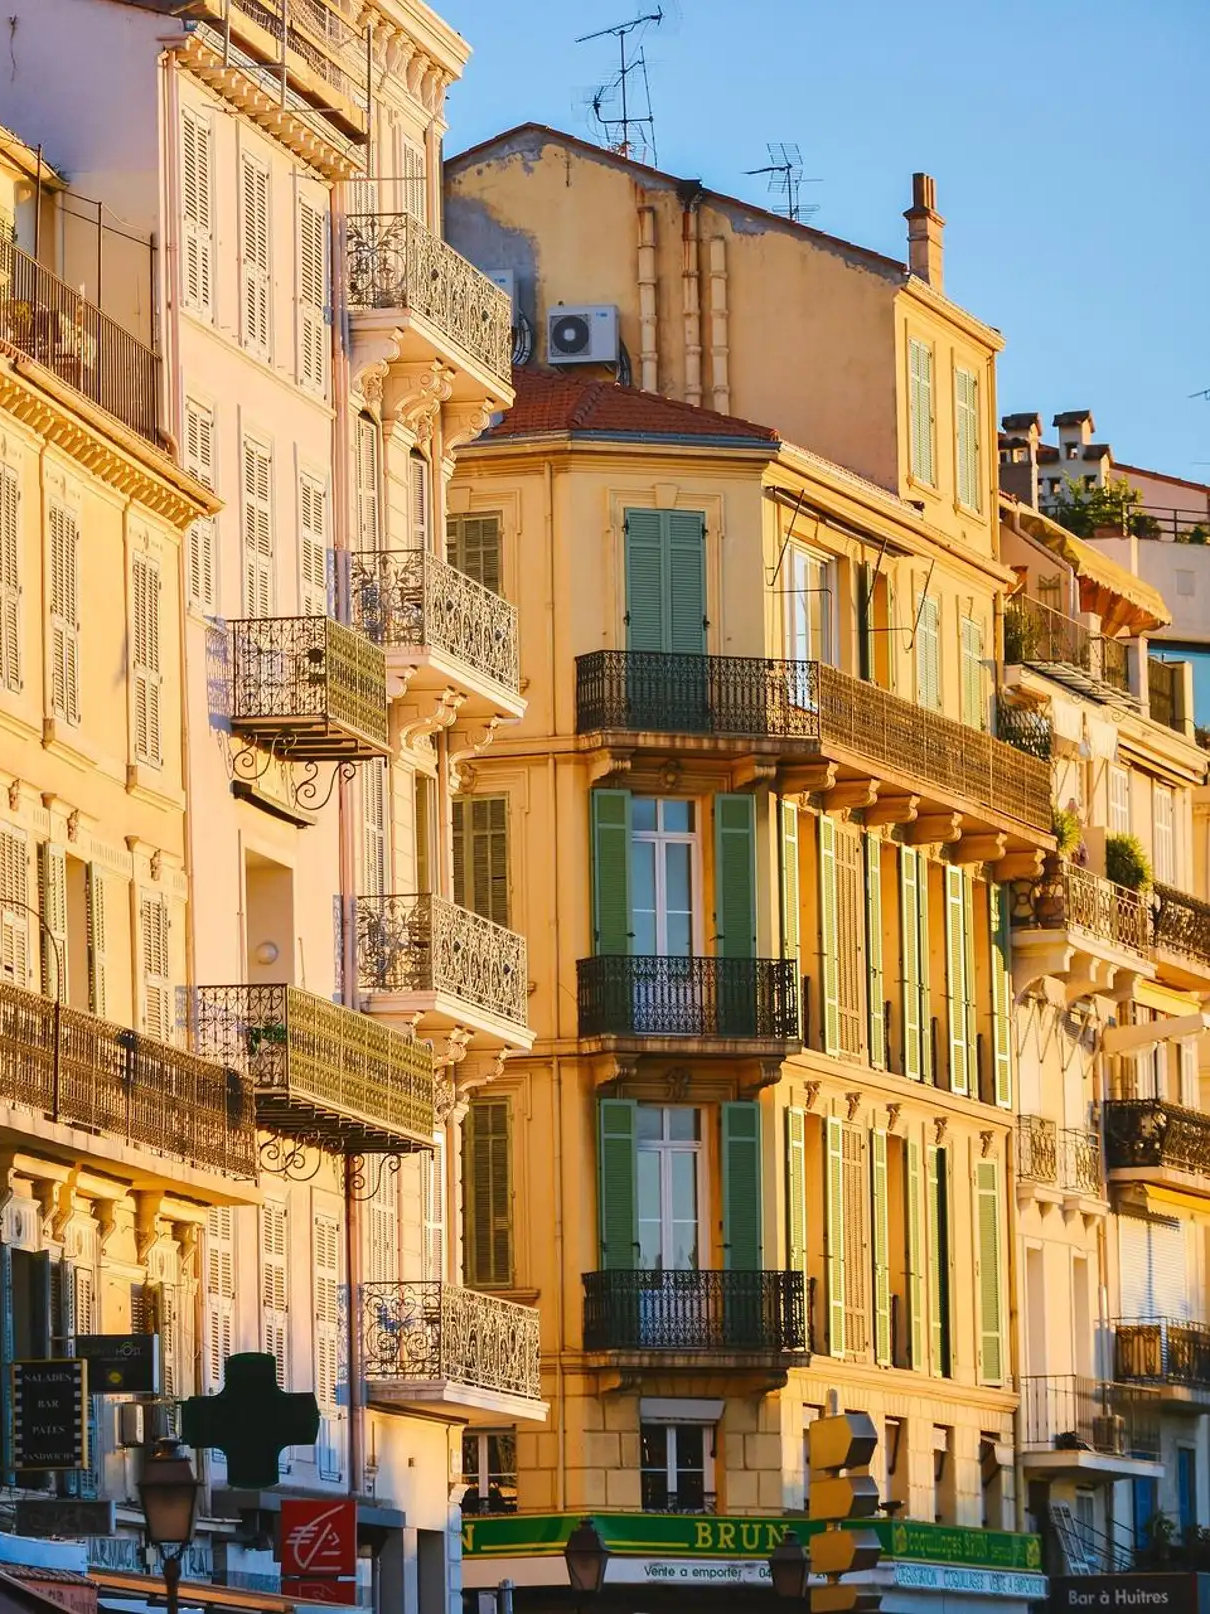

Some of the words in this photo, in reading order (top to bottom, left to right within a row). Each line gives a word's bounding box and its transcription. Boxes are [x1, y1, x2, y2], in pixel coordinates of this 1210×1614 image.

[37, 1399, 60, 1409] BAR
[694, 1522, 791, 1551] BRUN
[644, 1565, 676, 1578] Vente
[692, 1566, 742, 1580] emporter
[1068, 1589, 1095, 1605] Bar
[1099, 1590, 1110, 1605] à
